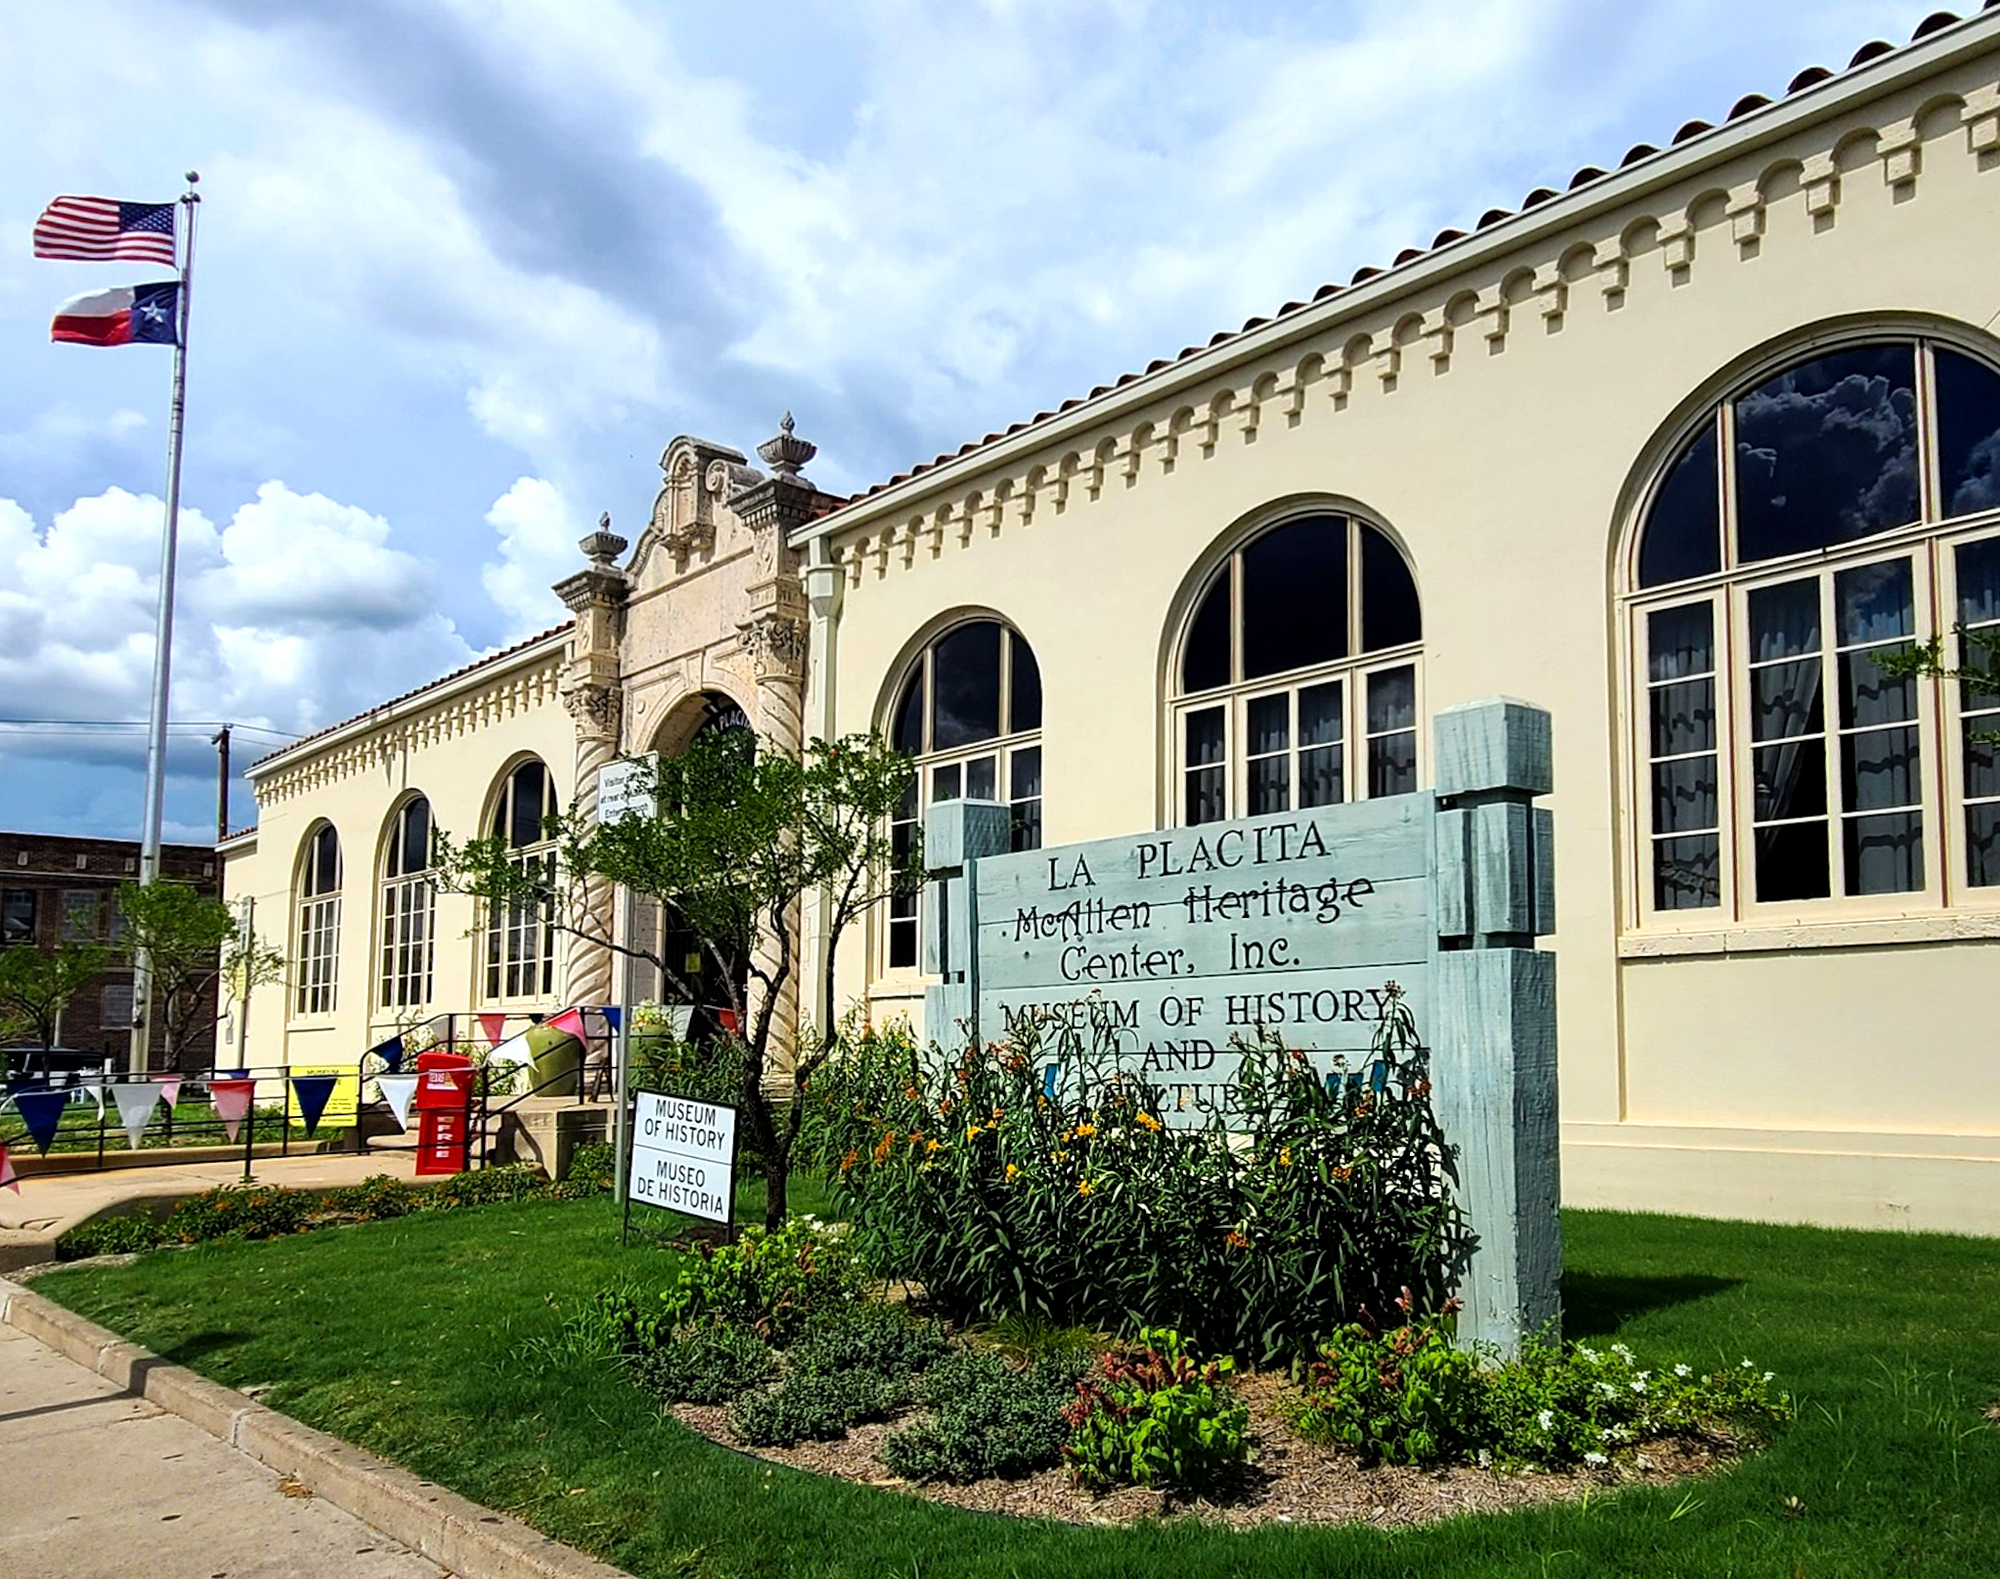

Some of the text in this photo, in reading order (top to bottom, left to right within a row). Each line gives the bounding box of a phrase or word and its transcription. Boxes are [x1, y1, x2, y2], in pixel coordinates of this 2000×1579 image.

[1048, 821, 1331, 891] LA PLACITA
[1014, 877, 1375, 942] McAllen Heritage
[1061, 933, 1300, 981] Center, Inc.
[1002, 989, 1394, 1031] MUSEUM OF HISTORY
[1141, 1039, 1216, 1072] AND
[655, 1099, 716, 1127] MUSEUM
[644, 1118, 725, 1151] OF HISTORY
[656, 1160, 705, 1187] MUSEO
[637, 1177, 724, 1215] DE HISTORIA
